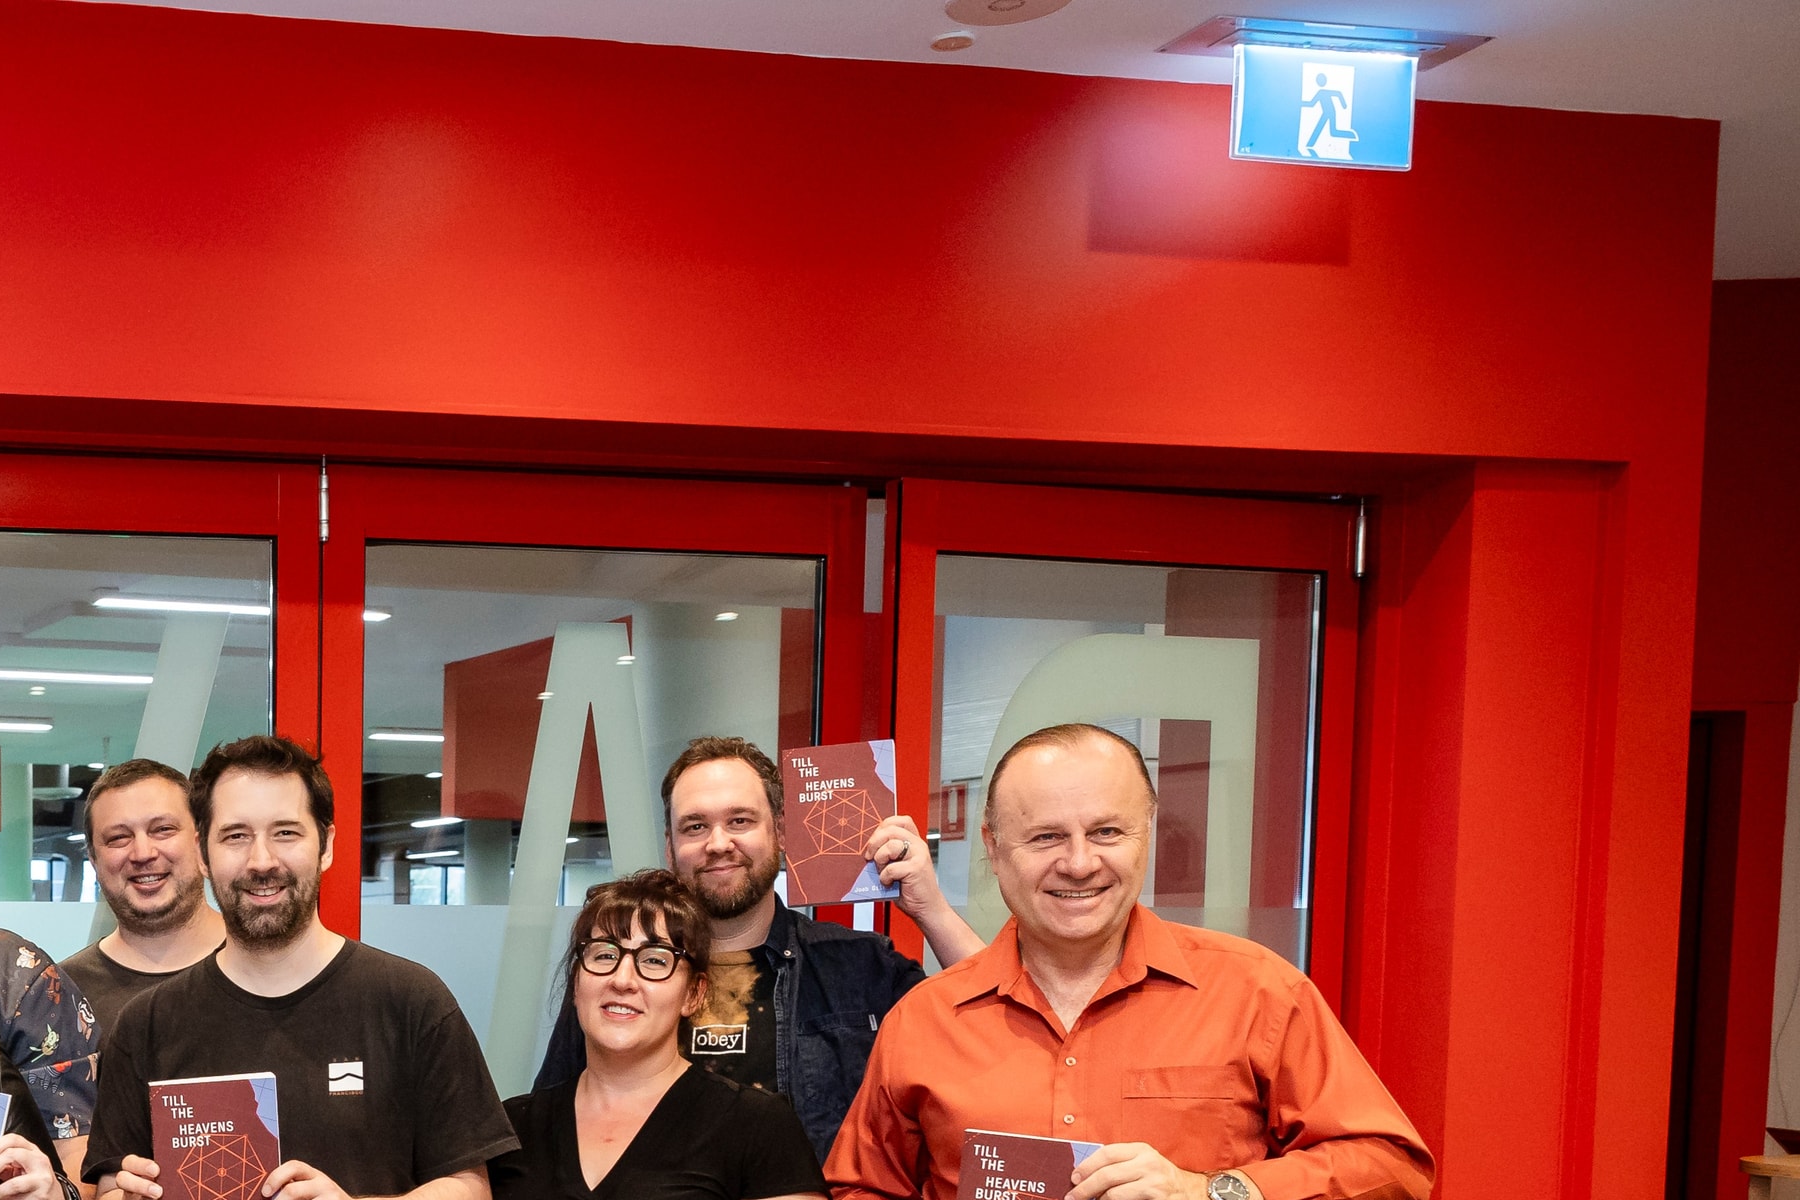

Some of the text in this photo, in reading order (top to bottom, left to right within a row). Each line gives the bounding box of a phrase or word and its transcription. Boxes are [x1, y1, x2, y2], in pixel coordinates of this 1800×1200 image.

[791, 757, 813, 768] TILL
[798, 767, 819, 778] THE
[805, 777, 855, 791] HEAVENS
[799, 790, 834, 803] BURST
[696, 1031, 741, 1049] obey
[161, 1095, 187, 1107] TILL
[170, 1107, 194, 1119] THE
[179, 1120, 234, 1136] HEAVENS
[172, 1135, 211, 1149] BURST
[973, 1144, 999, 1158] TILL
[980, 1158, 1005, 1172] THE
[985, 1176, 1046, 1194] HEAVENS
